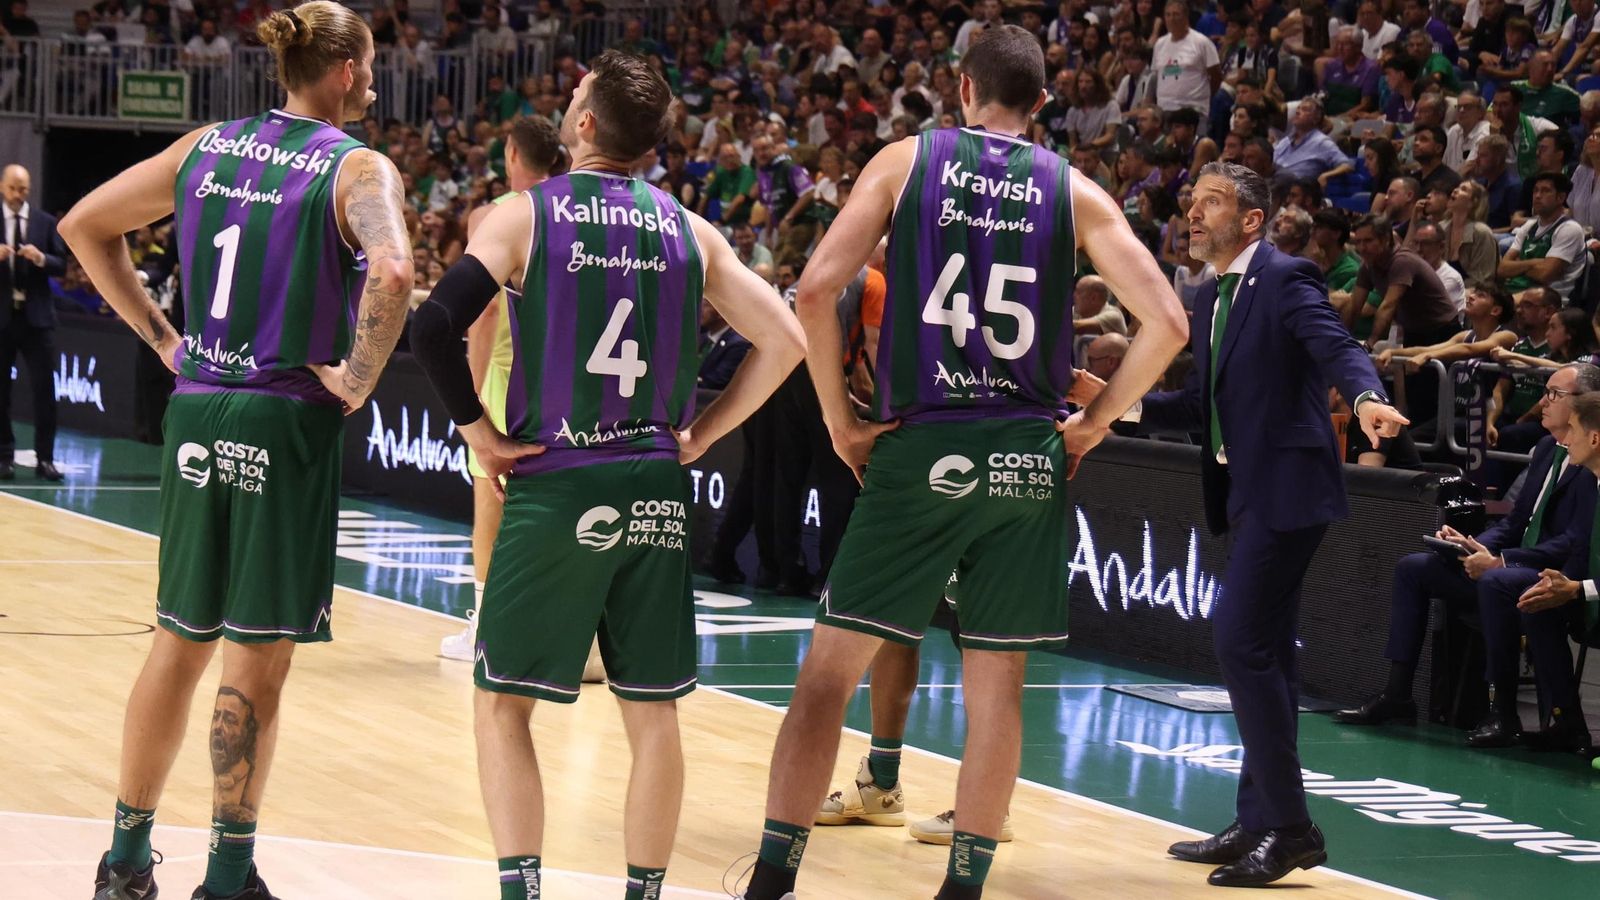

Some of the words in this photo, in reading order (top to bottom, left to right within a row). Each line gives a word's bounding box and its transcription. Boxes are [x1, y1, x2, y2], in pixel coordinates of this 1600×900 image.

[198, 129, 335, 175] Osetkowski
[941, 161, 1042, 205] Kravish
[552, 195, 678, 237] Kalinoski
[211, 225, 240, 319] 1
[922, 253, 1036, 360] 45
[586, 297, 647, 398] 4
[214, 440, 270, 466] COSTA
[988, 453, 1054, 472] COSTA
[216, 457, 237, 473] DEL
[239, 461, 266, 481] SOL
[989, 471, 1024, 484] DEL
[1028, 472, 1054, 487] SOL
[988, 484, 1053, 501] MÁLAGA
[631, 500, 687, 519] COSTA
[628, 519, 662, 533] DEL
[662, 520, 687, 536] SOL
[626, 532, 684, 551] MÁLAGA
[1068, 505, 1223, 620] Andalu
